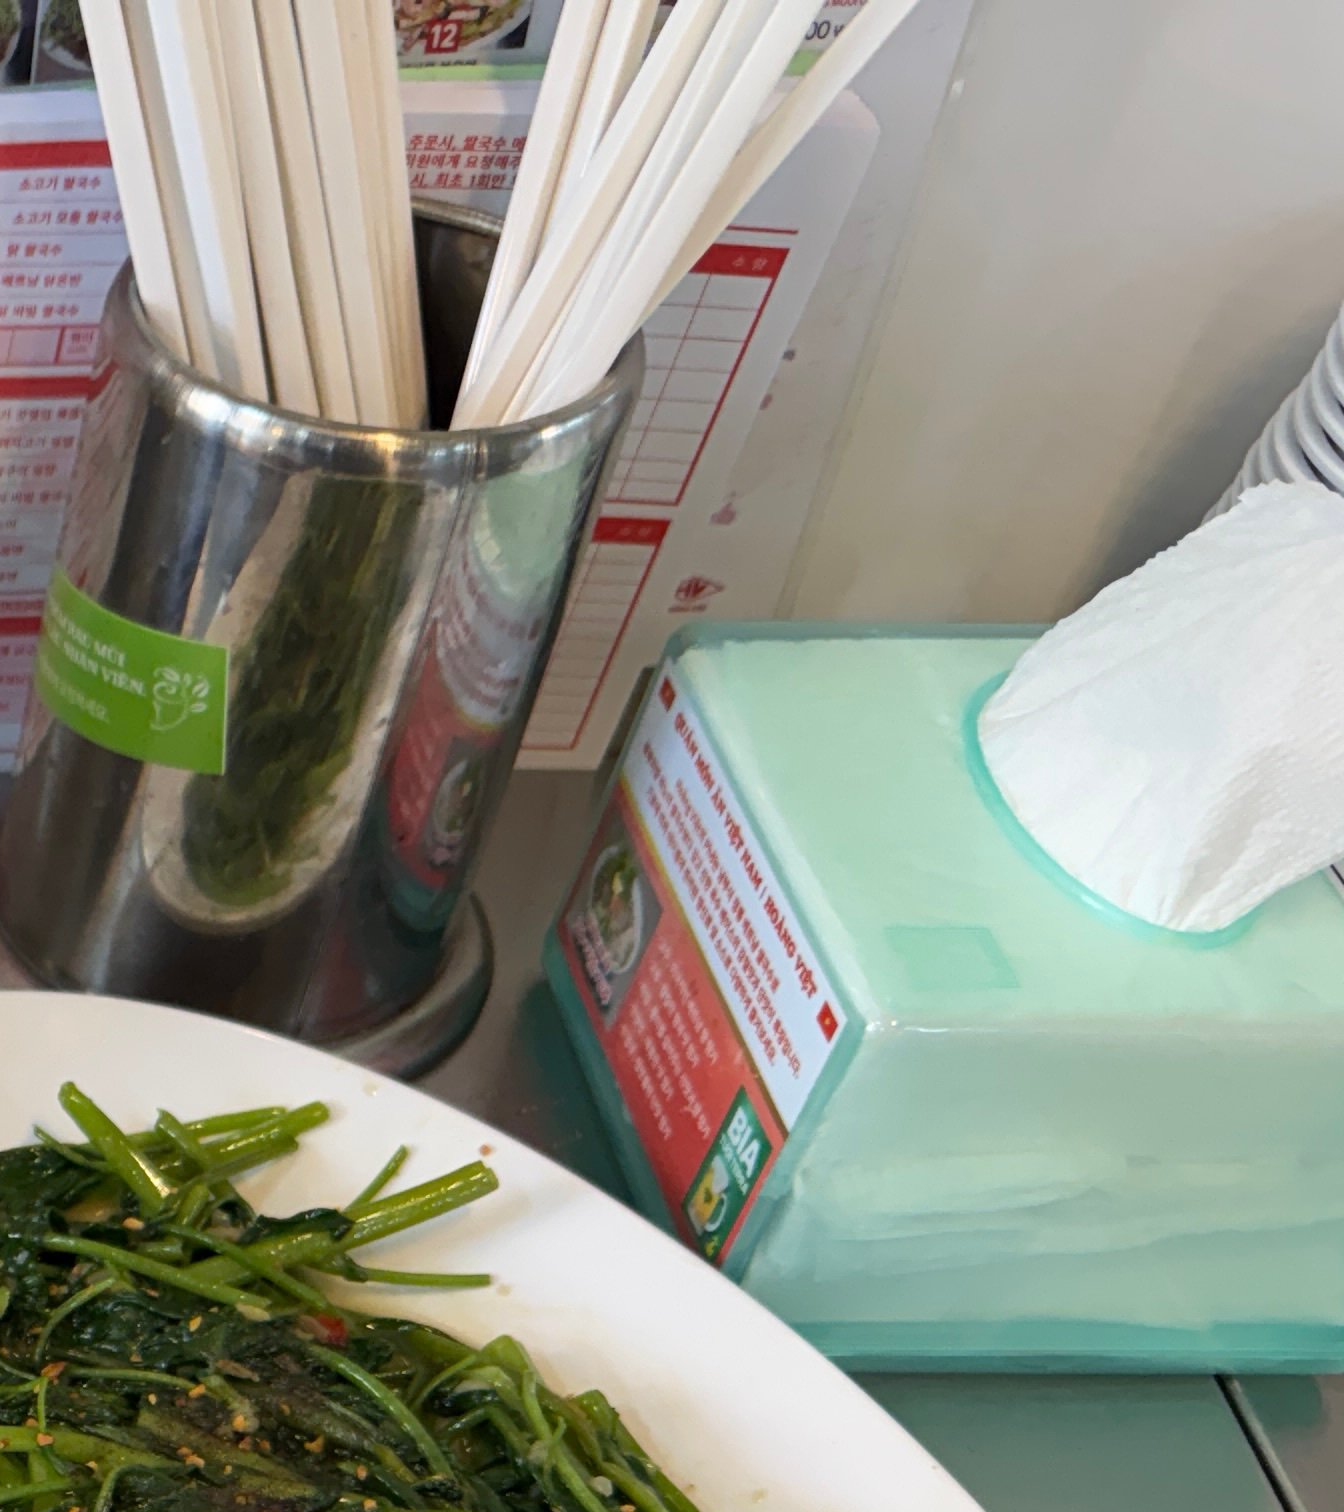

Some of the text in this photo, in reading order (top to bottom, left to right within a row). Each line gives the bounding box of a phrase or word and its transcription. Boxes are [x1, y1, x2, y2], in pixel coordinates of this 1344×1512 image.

[431, 23, 458, 48] 12
[410, 134, 507, 151] 주문시, 쌀국수
[19, 176, 102, 191] 소고기 쌀국수
[14, 211, 52, 224] 소고기
[740, 845, 762, 893] NAM
[726, 1103, 763, 1180] BIA
